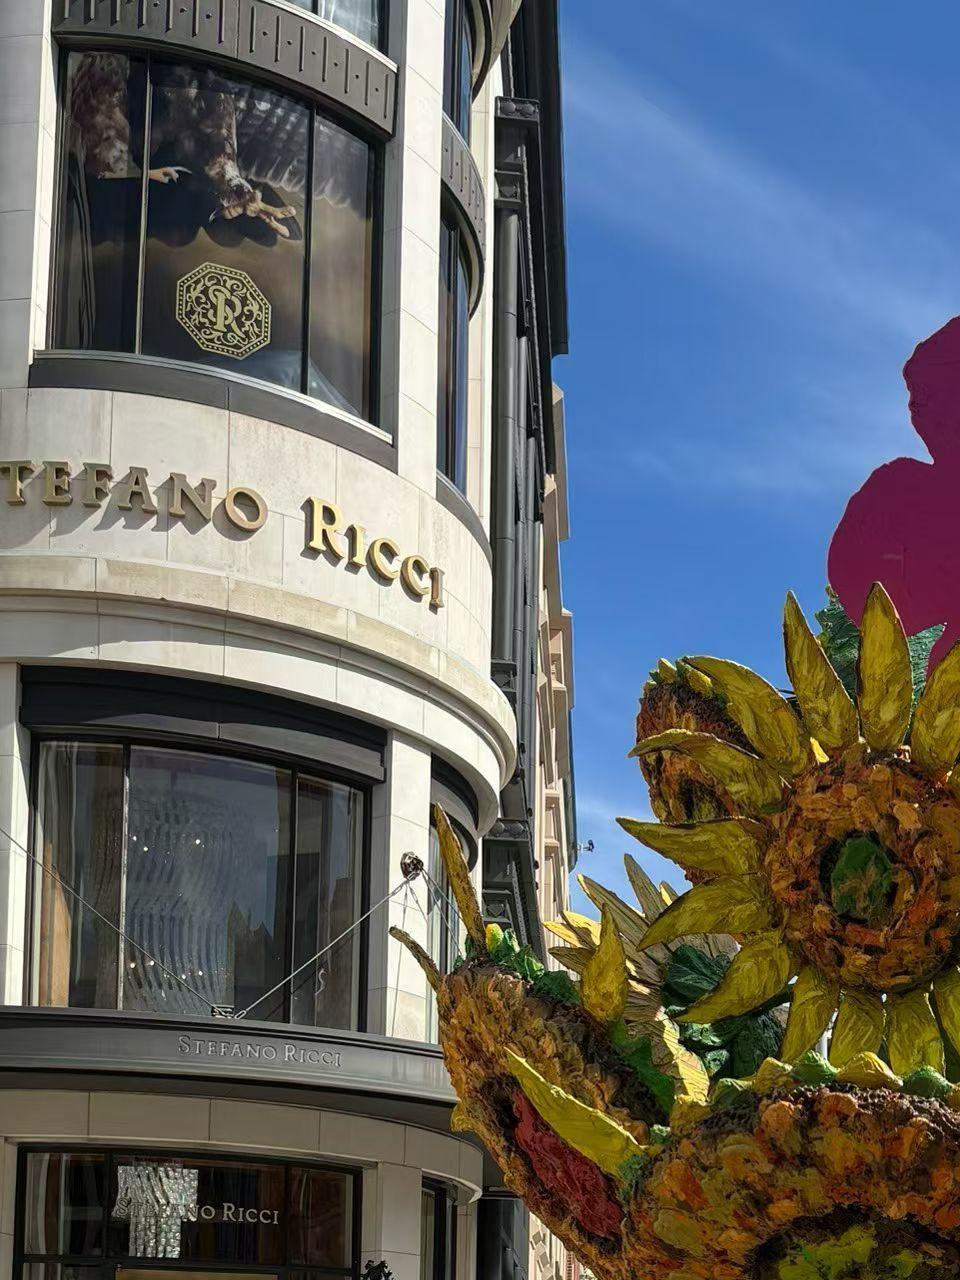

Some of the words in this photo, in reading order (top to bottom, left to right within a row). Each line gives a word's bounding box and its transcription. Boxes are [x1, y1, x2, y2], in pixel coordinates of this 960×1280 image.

[0, 460, 268, 531] TEFANO
[302, 497, 446, 608] RICCI
[178, 1034, 278, 1060] STEFANO
[284, 1043, 342, 1067] RICCI
[222, 1202, 279, 1225] RICCI
